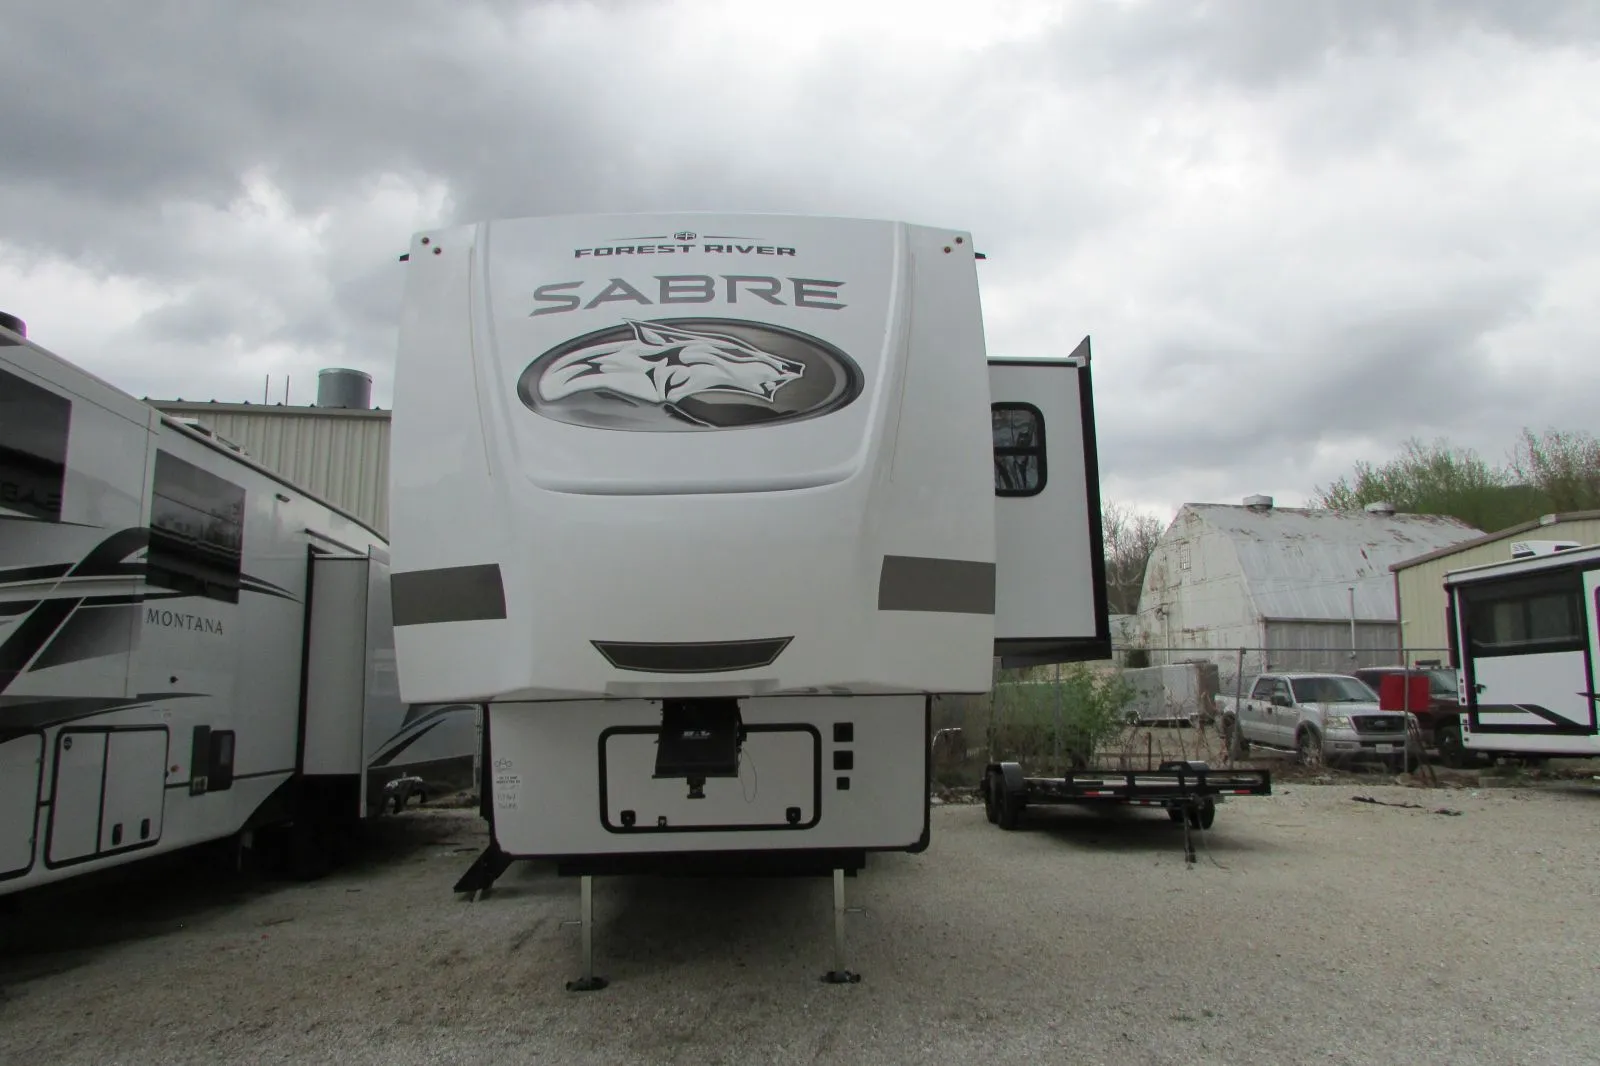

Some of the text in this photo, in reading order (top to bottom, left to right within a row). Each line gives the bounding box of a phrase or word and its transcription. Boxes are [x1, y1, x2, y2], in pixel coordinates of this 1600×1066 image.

[574, 244, 797, 258] FOREST RIVER
[528, 275, 848, 317] SABRE
[147, 608, 224, 636] MONTANA
